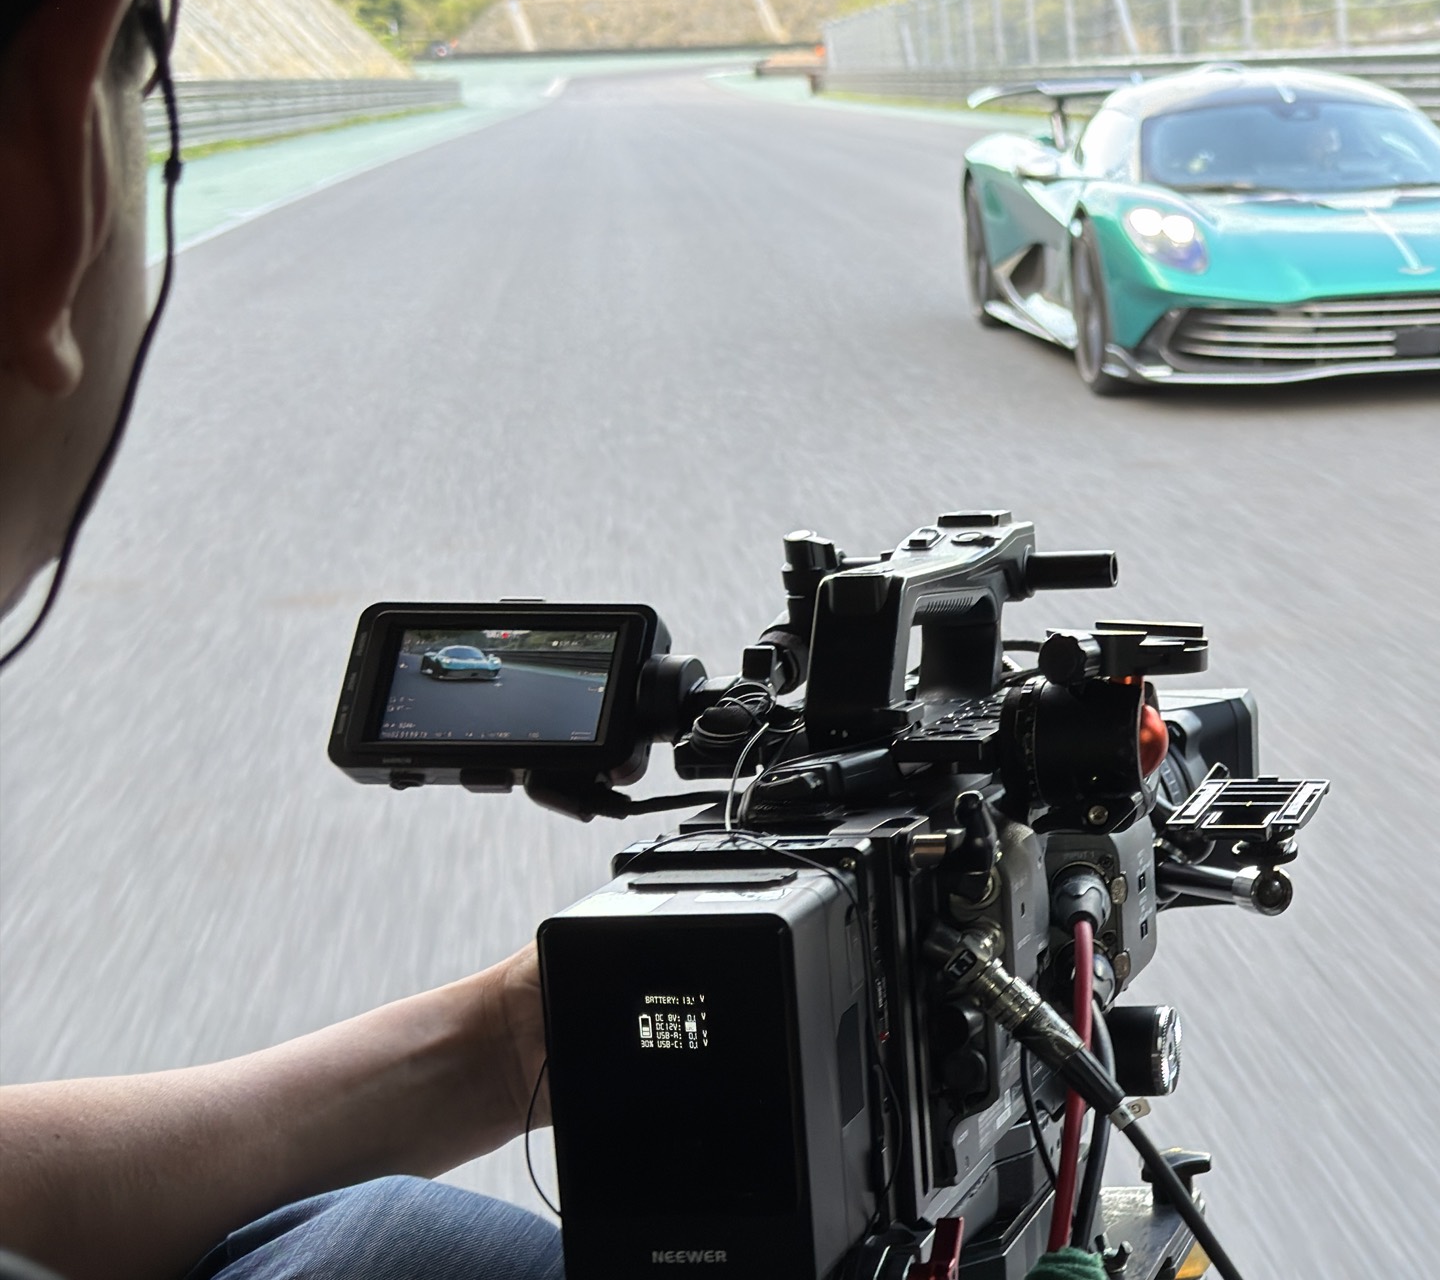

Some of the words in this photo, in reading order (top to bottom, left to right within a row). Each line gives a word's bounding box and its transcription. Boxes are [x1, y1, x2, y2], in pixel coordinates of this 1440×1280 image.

[645, 995, 679, 1004] BATTERY:
[655, 1013, 664, 1022] DC
[657, 1040, 683, 1048] USB-C:
[651, 1249, 728, 1264] NEEWER
